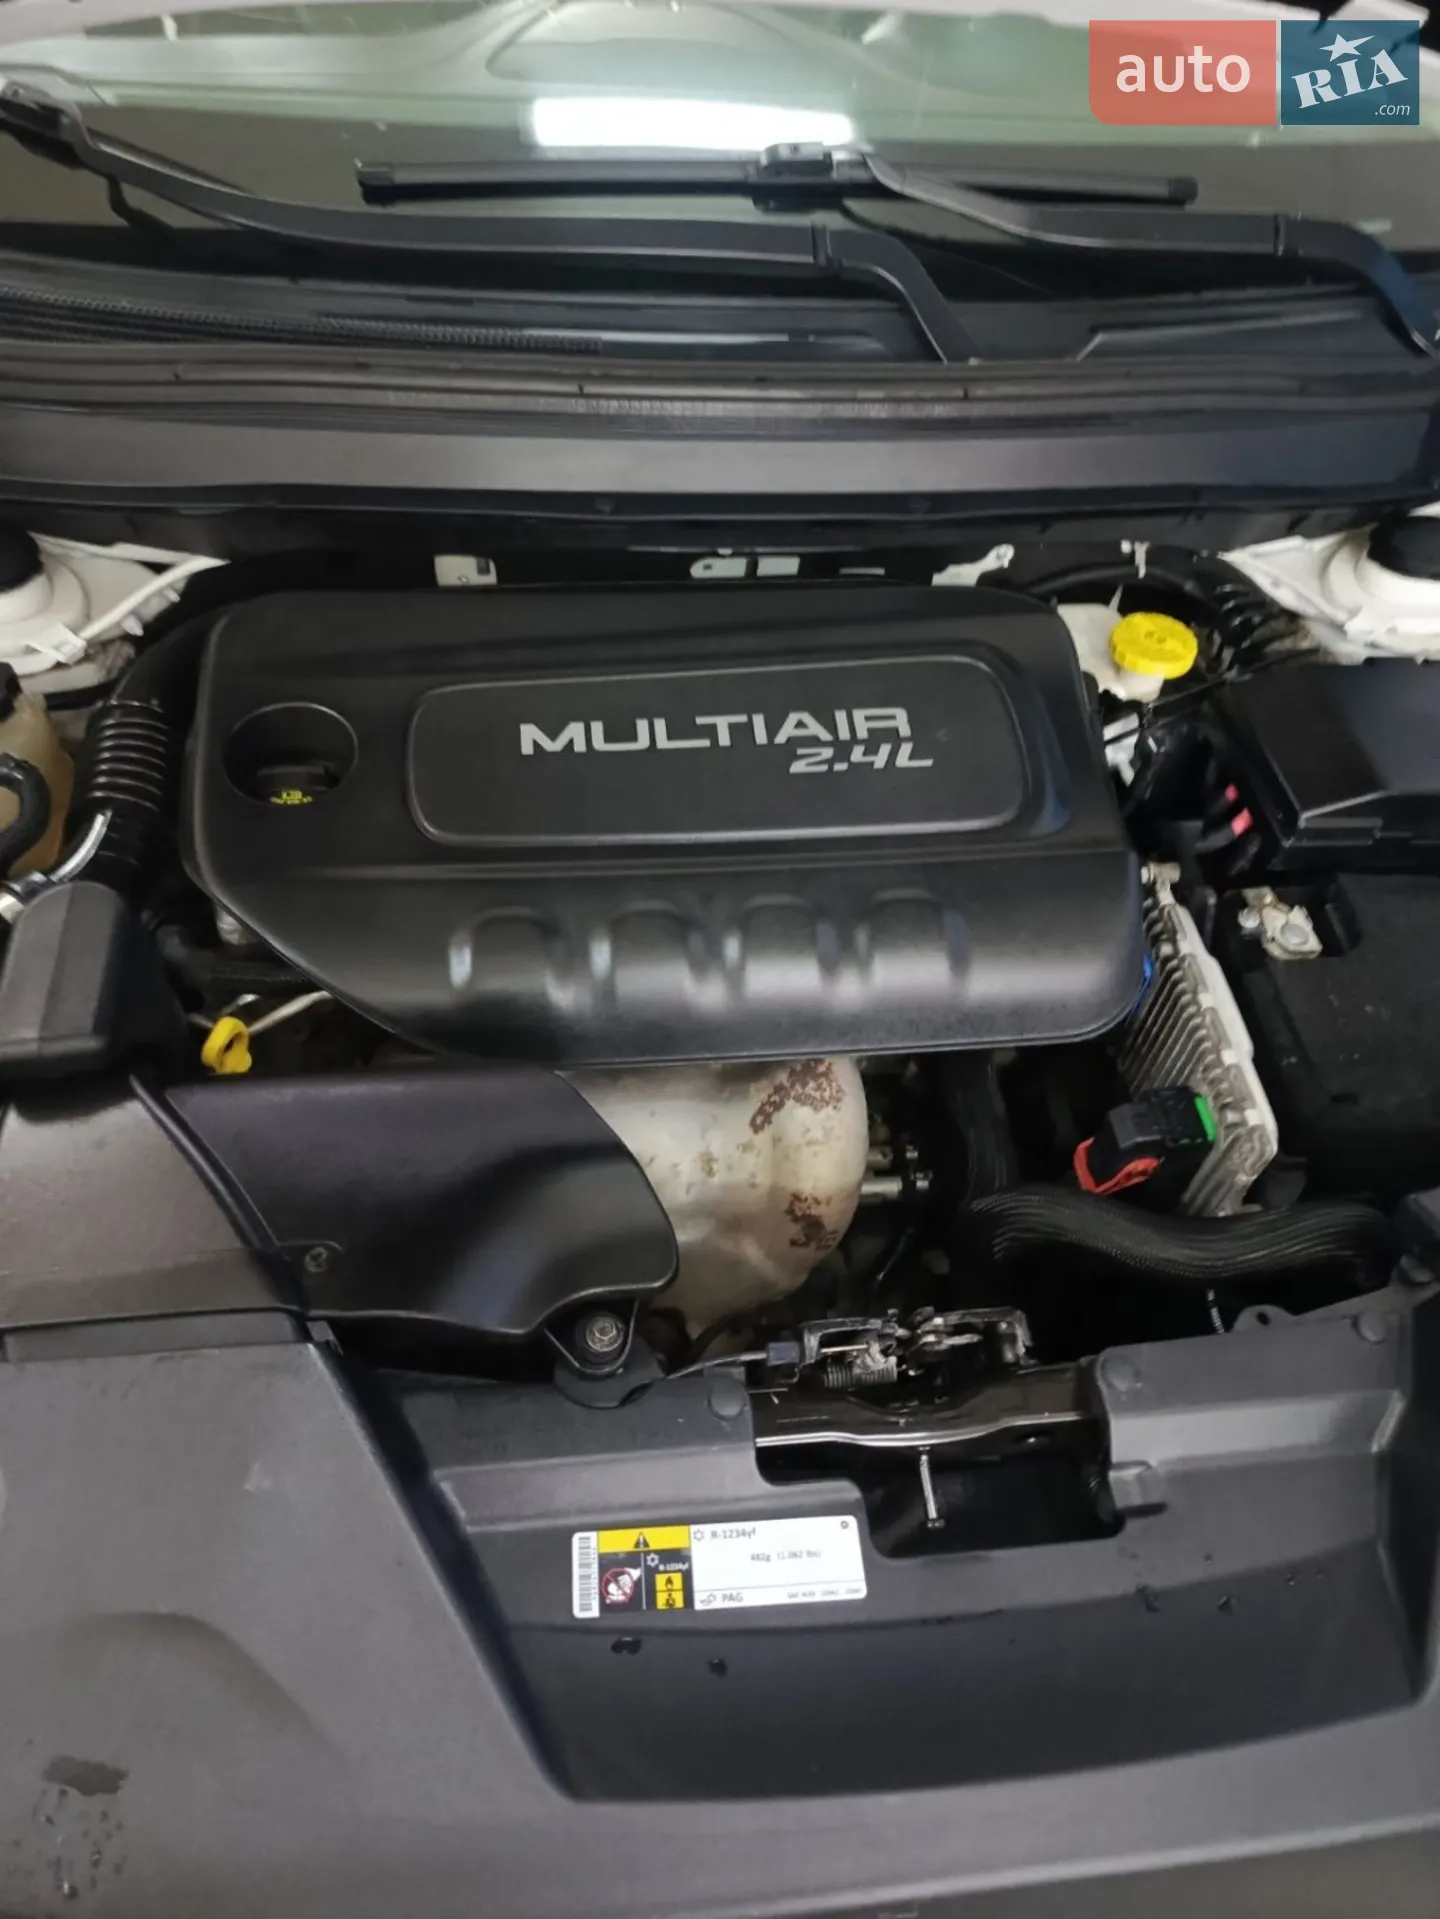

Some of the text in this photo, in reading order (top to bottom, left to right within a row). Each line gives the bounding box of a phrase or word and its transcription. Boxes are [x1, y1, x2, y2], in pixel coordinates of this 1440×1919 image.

[519, 707, 911, 755] MULTIAIR
[789, 742, 934, 774] 2.4L
[710, 1527, 756, 1540] R-1234yf
[722, 1592, 743, 1603] PAG
